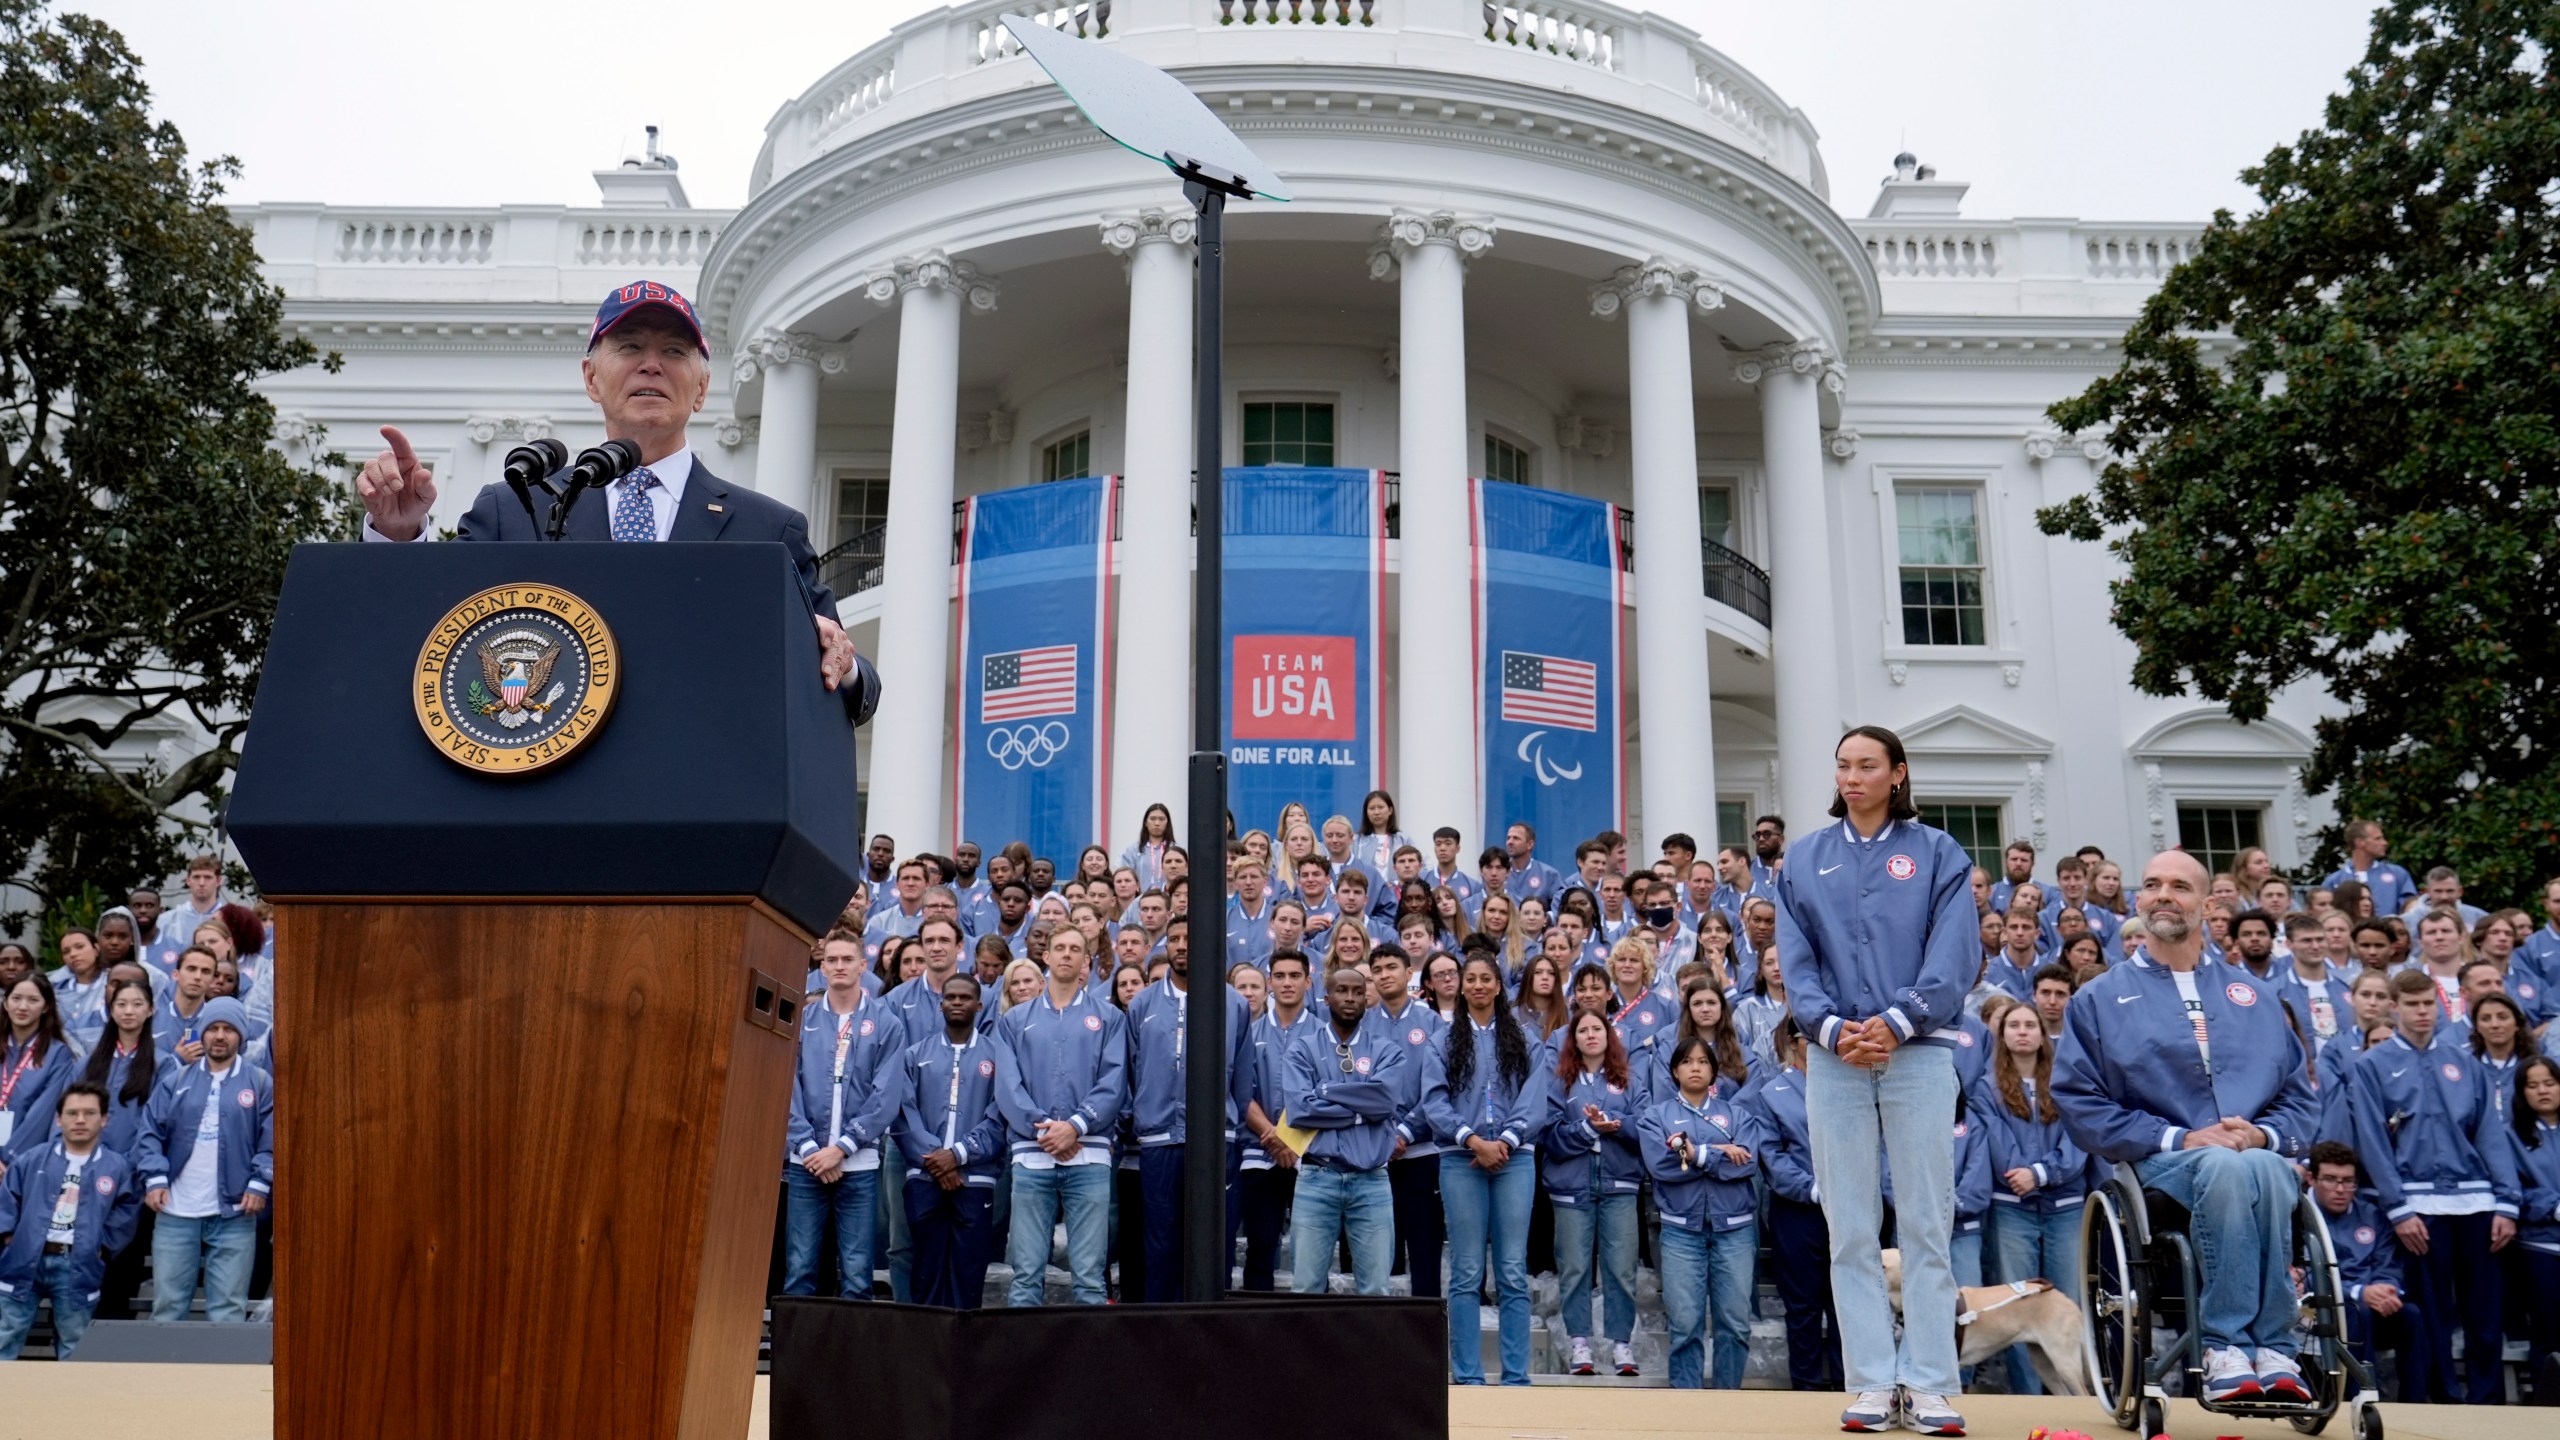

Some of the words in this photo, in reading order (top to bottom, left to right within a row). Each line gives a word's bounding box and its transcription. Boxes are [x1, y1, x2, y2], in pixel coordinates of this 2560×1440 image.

[618, 281, 691, 316] USA
[524, 592, 543, 604] OF
[547, 594, 571, 614] THE
[423, 590, 520, 674] PRESIDENT
[573, 611, 610, 687] UNITED
[1262, 654, 1323, 671] TEAM
[423, 681, 438, 709] THE
[1252, 674, 1335, 721] USA
[428, 711, 443, 727] OF
[526, 705, 597, 764] STATES
[440, 726, 490, 764] SEAL
[1231, 747, 1270, 764] ONE
[1276, 747, 1313, 765] FOR
[1317, 748, 1355, 766] ALL
